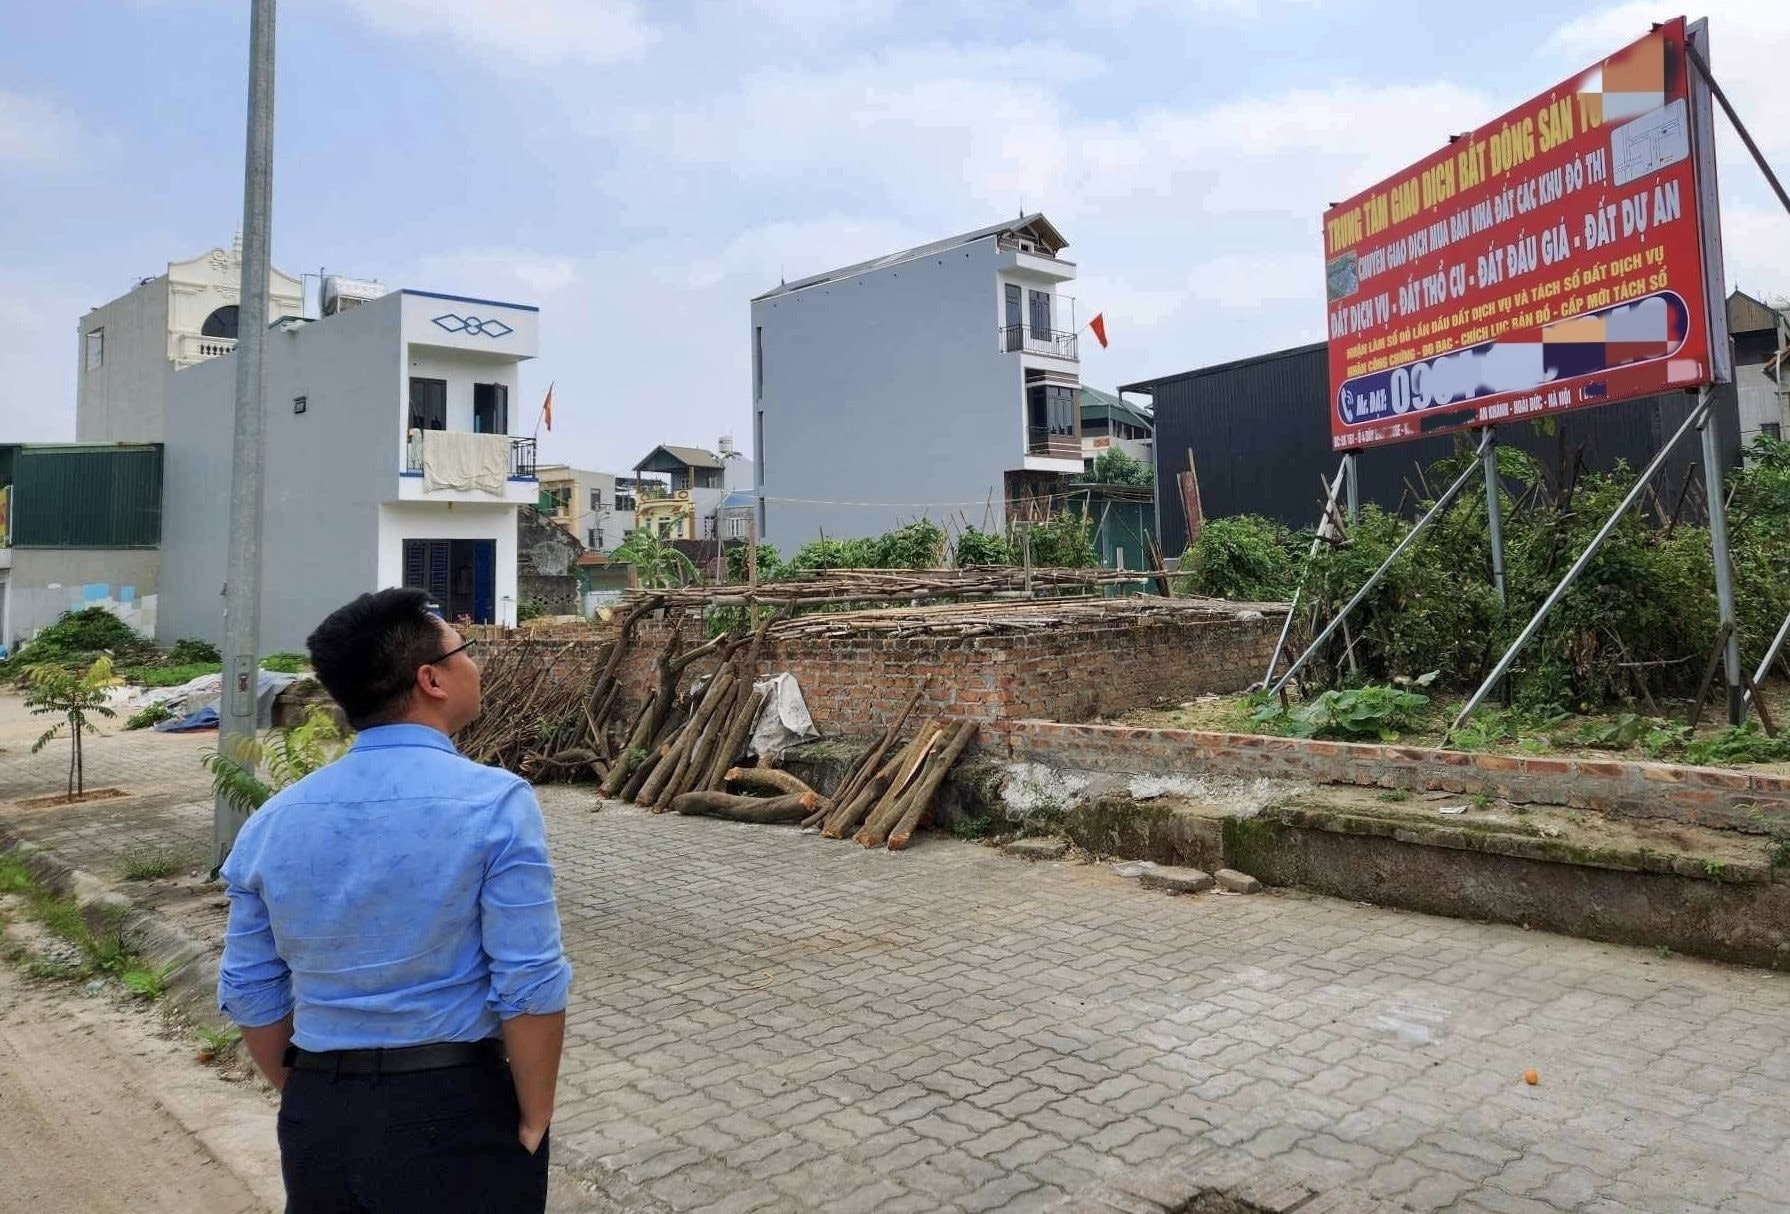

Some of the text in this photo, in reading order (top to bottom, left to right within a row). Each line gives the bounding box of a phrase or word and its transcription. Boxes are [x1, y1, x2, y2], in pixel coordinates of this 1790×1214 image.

[1328, 208, 1362, 253] TRUNG
[1363, 194, 1388, 236] TÂM
[1391, 178, 1419, 223] GIAO
[1422, 158, 1455, 212] DỊCH
[1459, 134, 1485, 191] BẤT
[1490, 117, 1534, 177] ĐỘNG
[1538, 94, 1573, 152] SẢN
